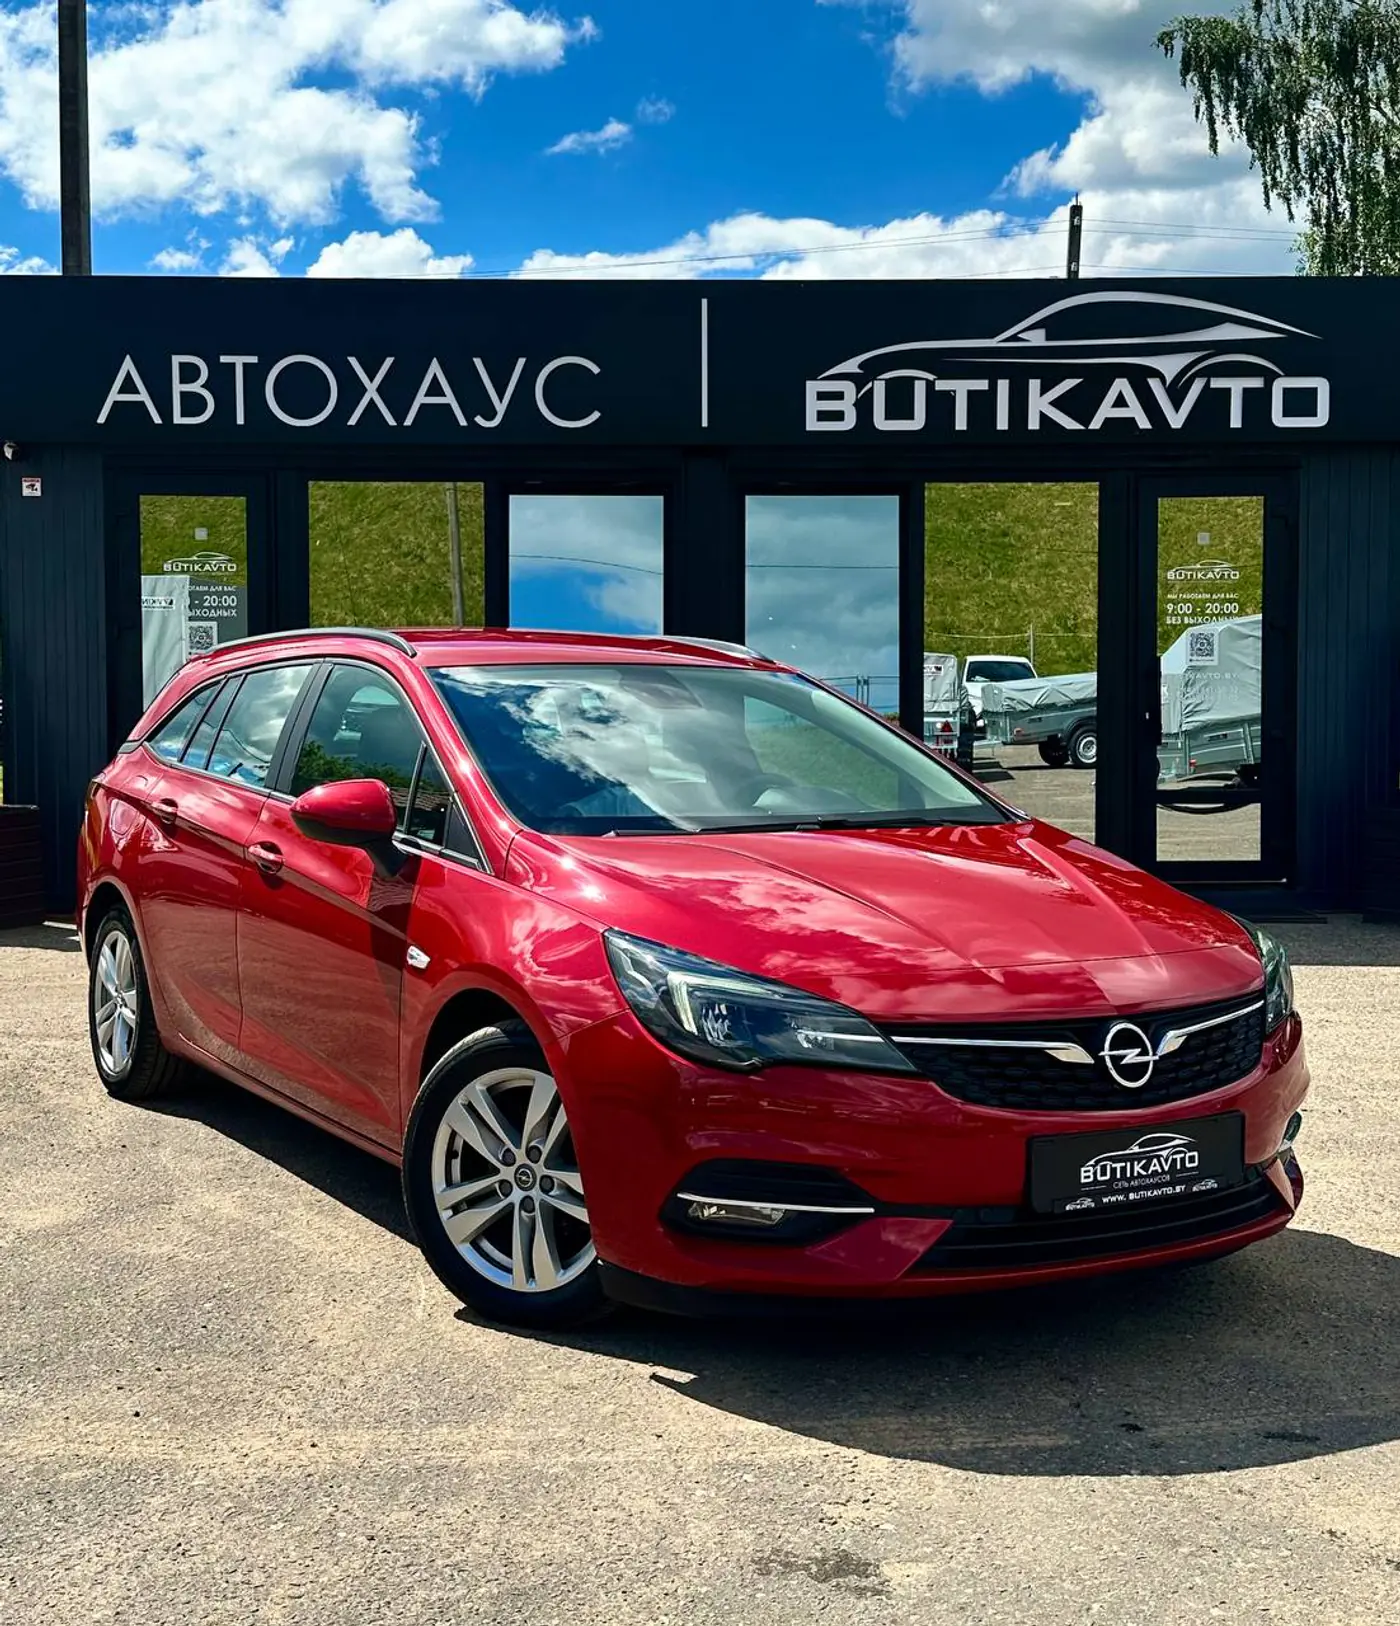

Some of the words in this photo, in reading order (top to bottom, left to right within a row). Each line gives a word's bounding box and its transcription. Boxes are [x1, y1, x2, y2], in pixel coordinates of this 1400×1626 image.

[96, 354, 601, 428] АВТОХАУС
[805, 376, 1330, 431] BUTIKAVTO
[163, 562, 237, 572] BUTIKAVTO
[1167, 571, 1239, 580] BUTIKAVTO
[203, 595, 237, 606] 20:00
[1166, 603, 1192, 614] 9:00
[1205, 603, 1239, 614] 20:00
[1166, 616, 1181, 625] БЕЗ
[1080, 1151, 1199, 1183] BUTIKAVTO
[1113, 1181, 1129, 1189] СЕТЬ
[1102, 1194, 1126, 1203] WWW.
[1129, 1185, 1186, 1200] BUTIKAVTO.BY
